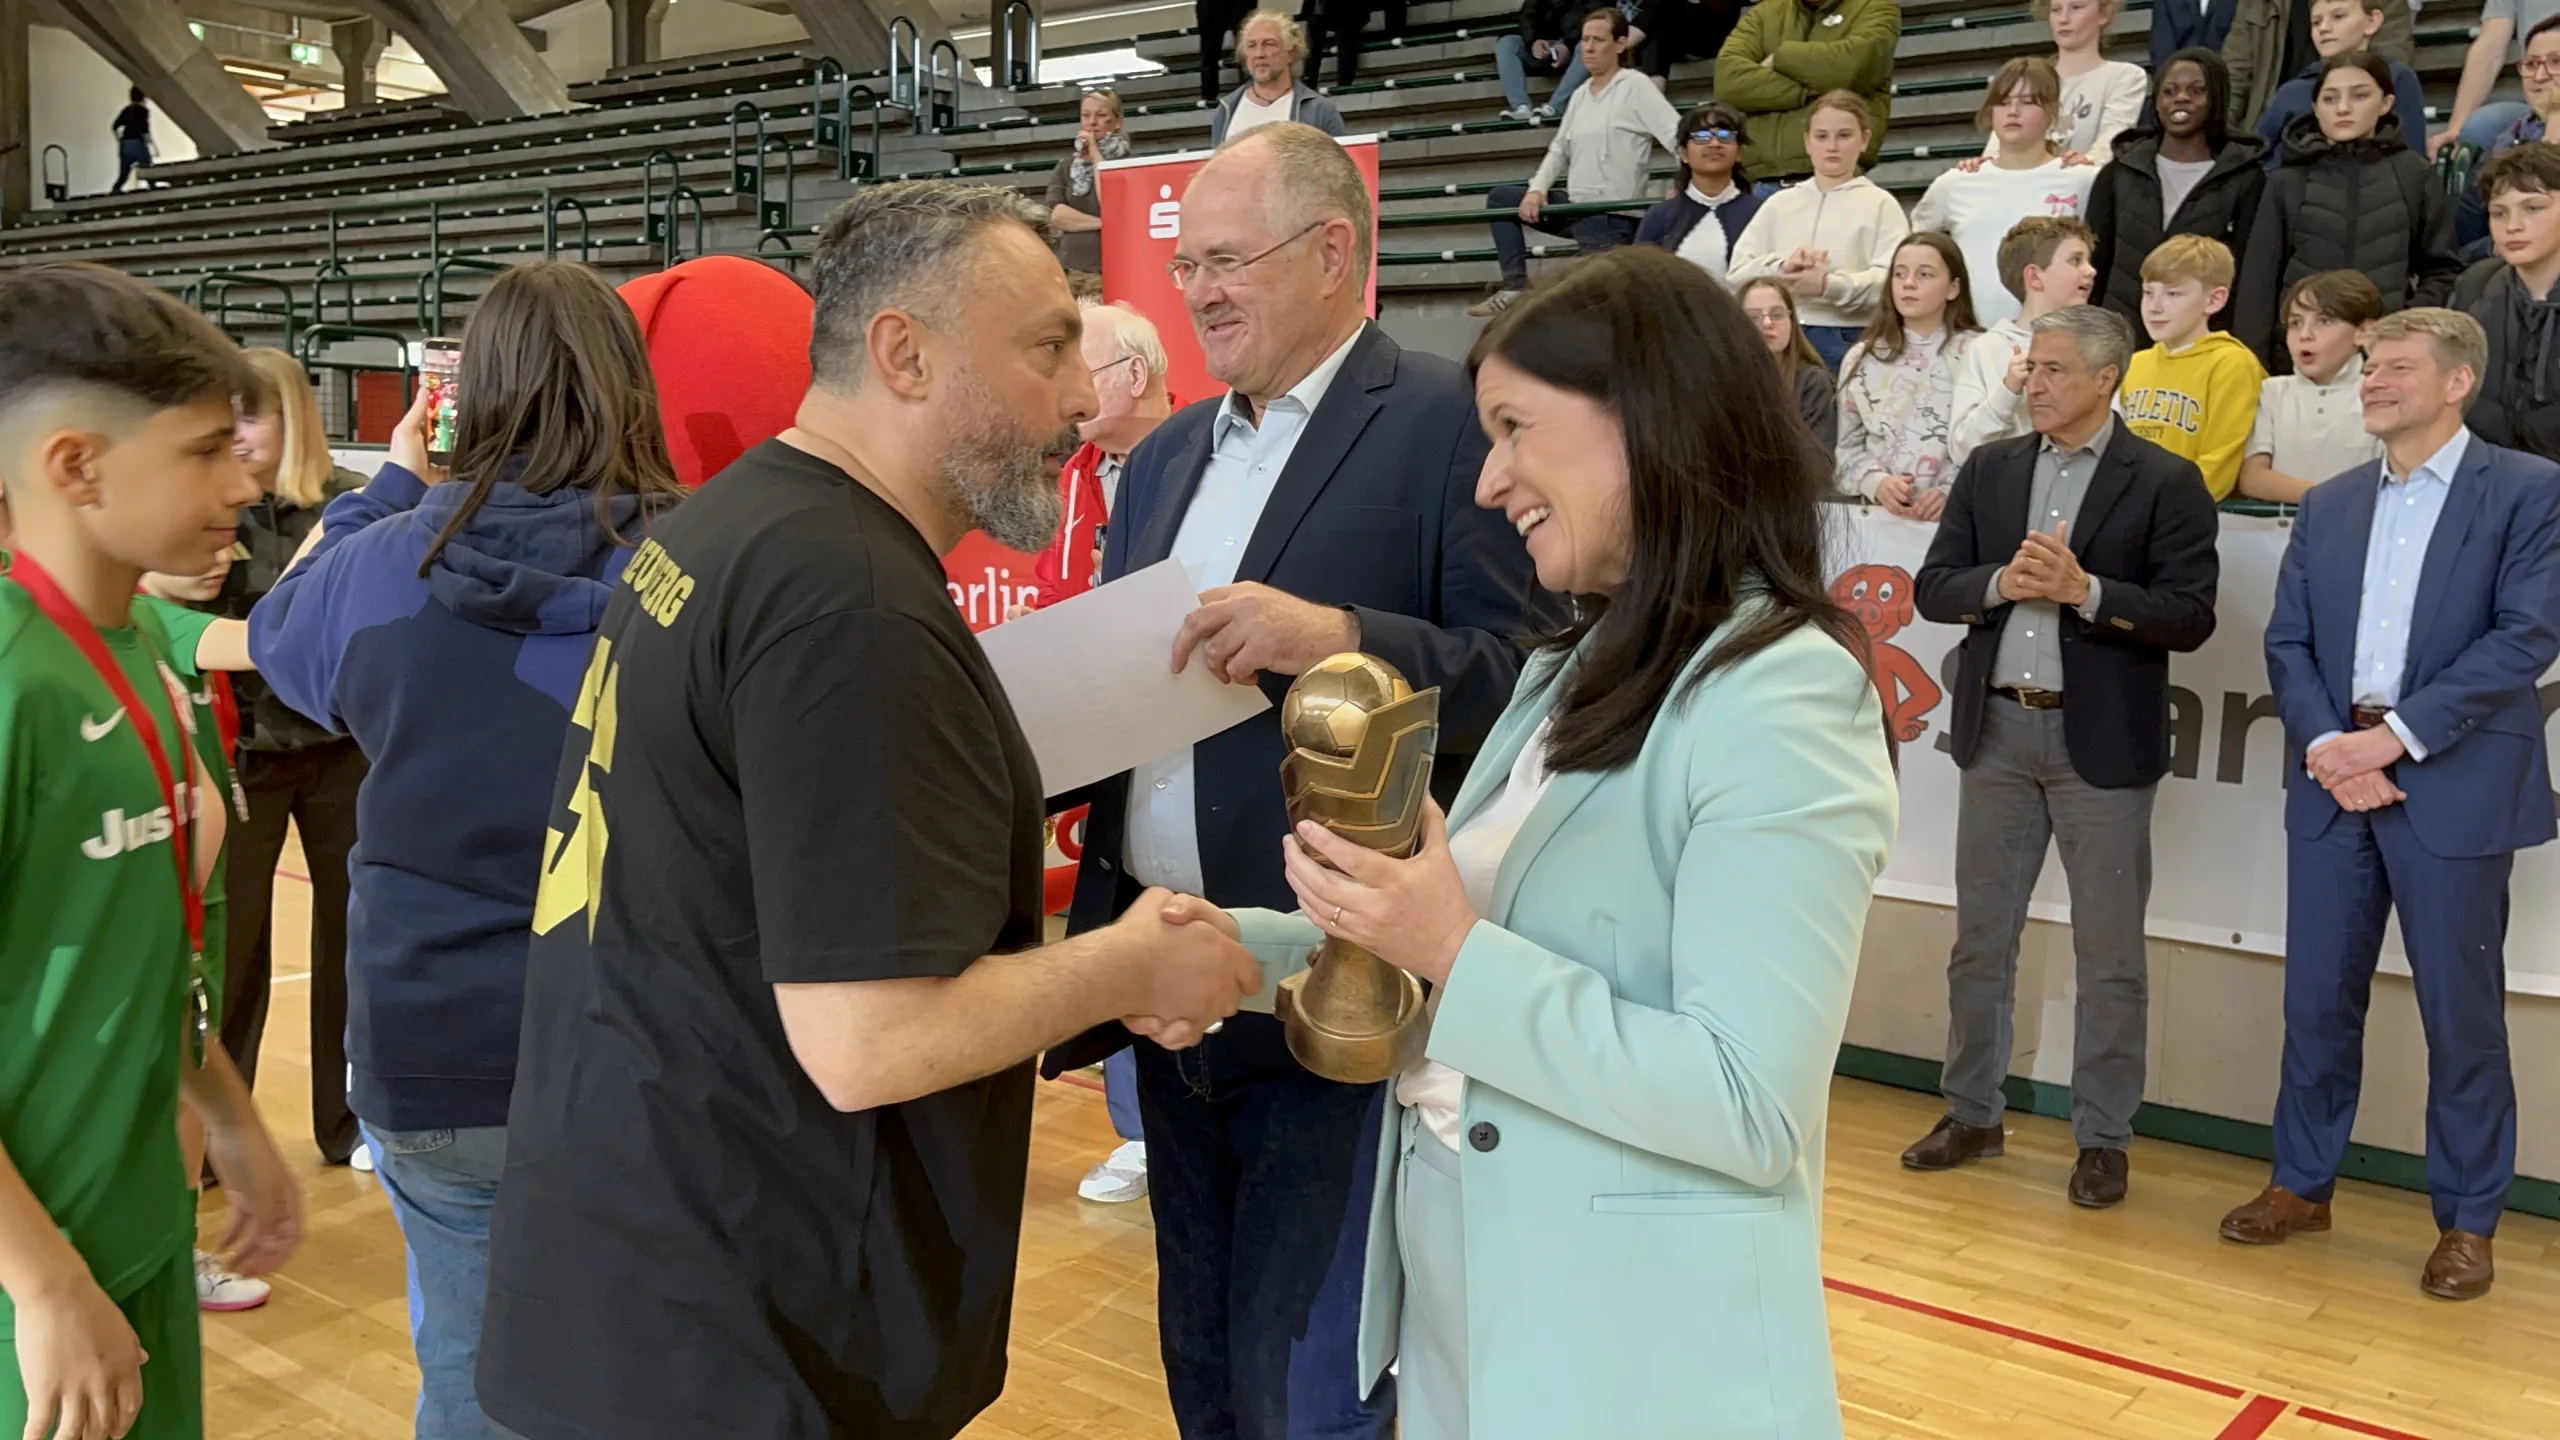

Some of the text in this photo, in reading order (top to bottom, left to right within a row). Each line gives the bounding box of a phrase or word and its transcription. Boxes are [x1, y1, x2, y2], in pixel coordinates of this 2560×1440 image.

[858, 158, 867, 173] 7
[744, 172, 751, 187] 7
[770, 210, 780, 225] 6
[2125, 387, 2201, 435] HLETIC
[946, 567, 1040, 625] erlin
